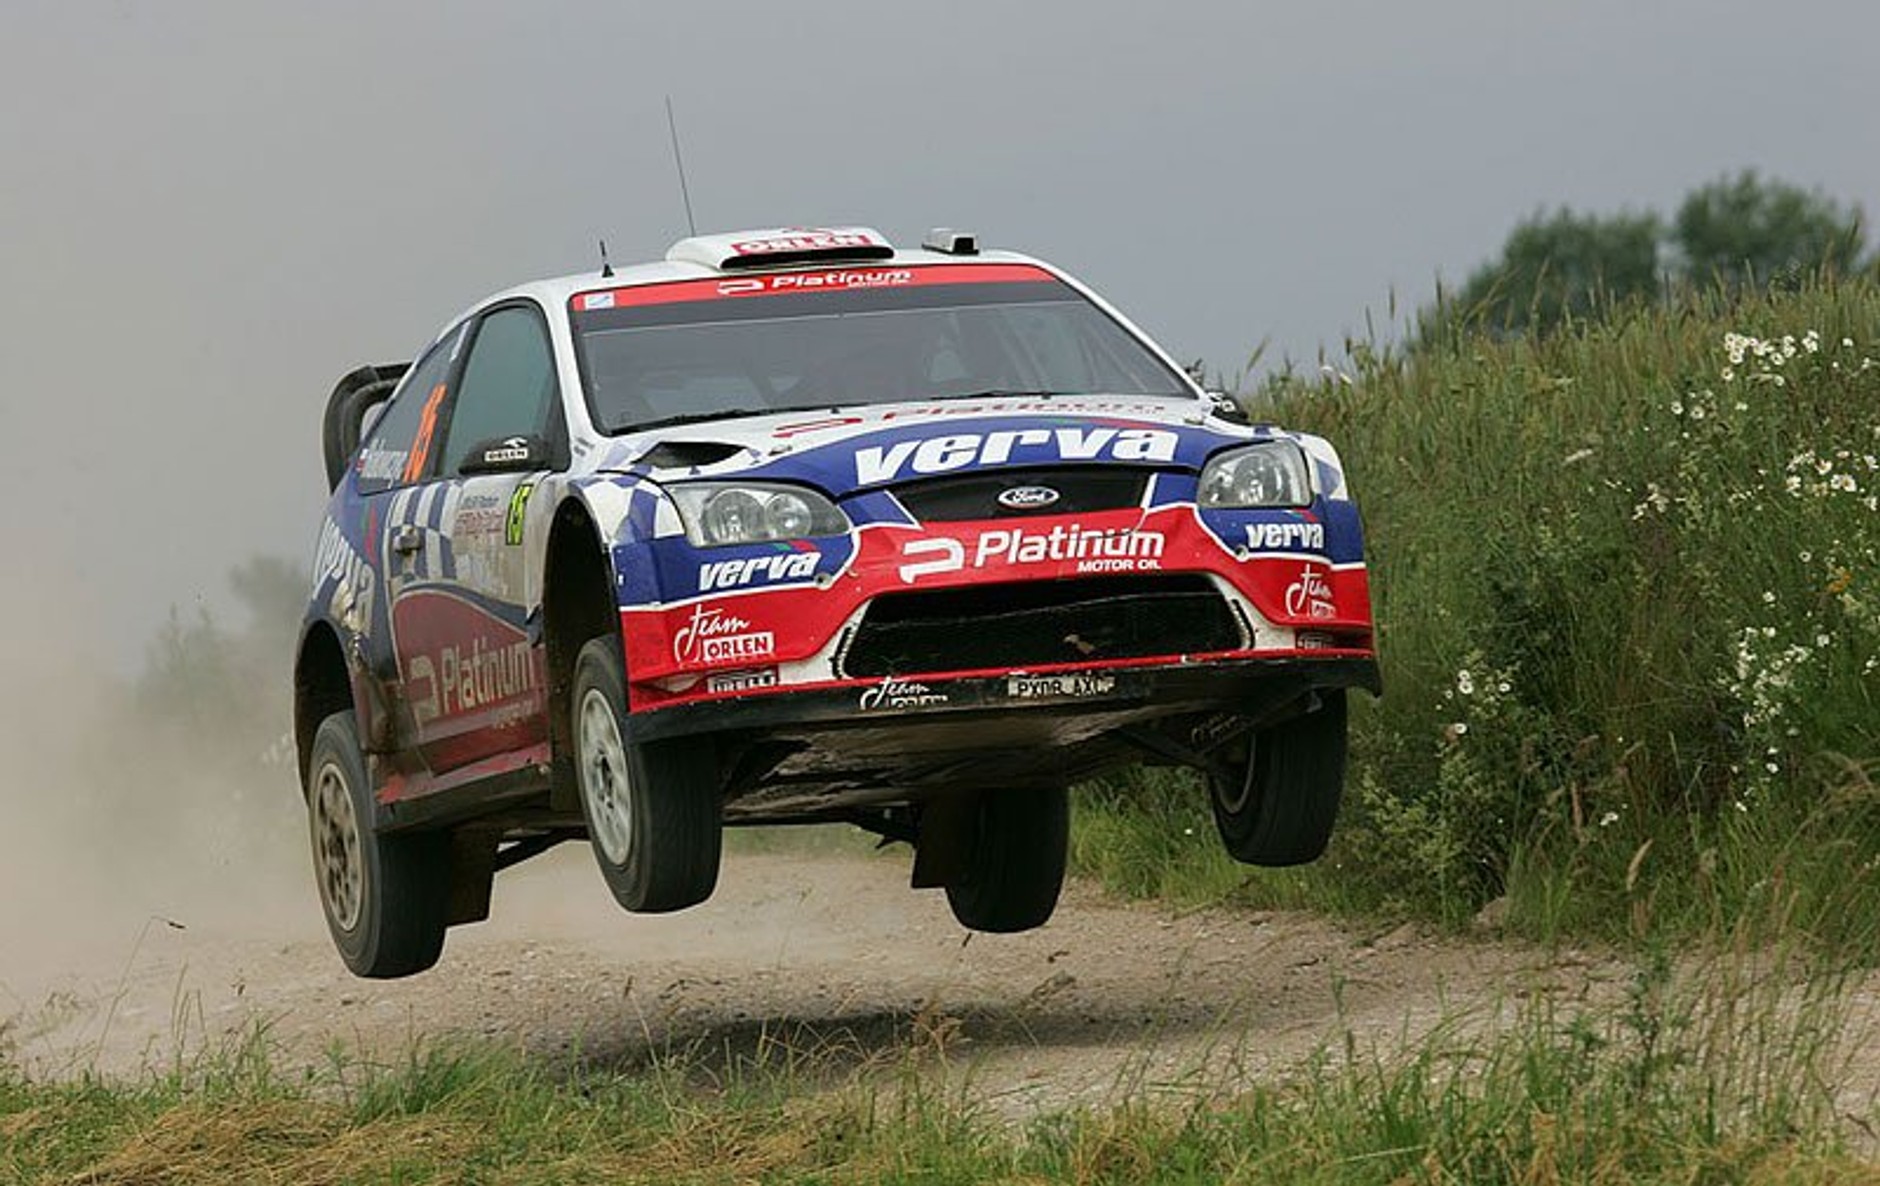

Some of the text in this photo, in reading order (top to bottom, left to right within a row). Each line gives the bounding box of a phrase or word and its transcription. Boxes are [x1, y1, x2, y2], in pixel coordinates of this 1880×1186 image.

[772, 271, 911, 288] Platinum
[854, 427, 1180, 486] verva
[974, 523, 1165, 567] Platinum
[1246, 522, 1324, 549] verva
[699, 551, 821, 591] verva
[1077, 559, 1162, 573] MOTOR OIL
[674, 603, 750, 662] team
[707, 636, 768, 657] ORLEN
[441, 636, 535, 714] Platinum
